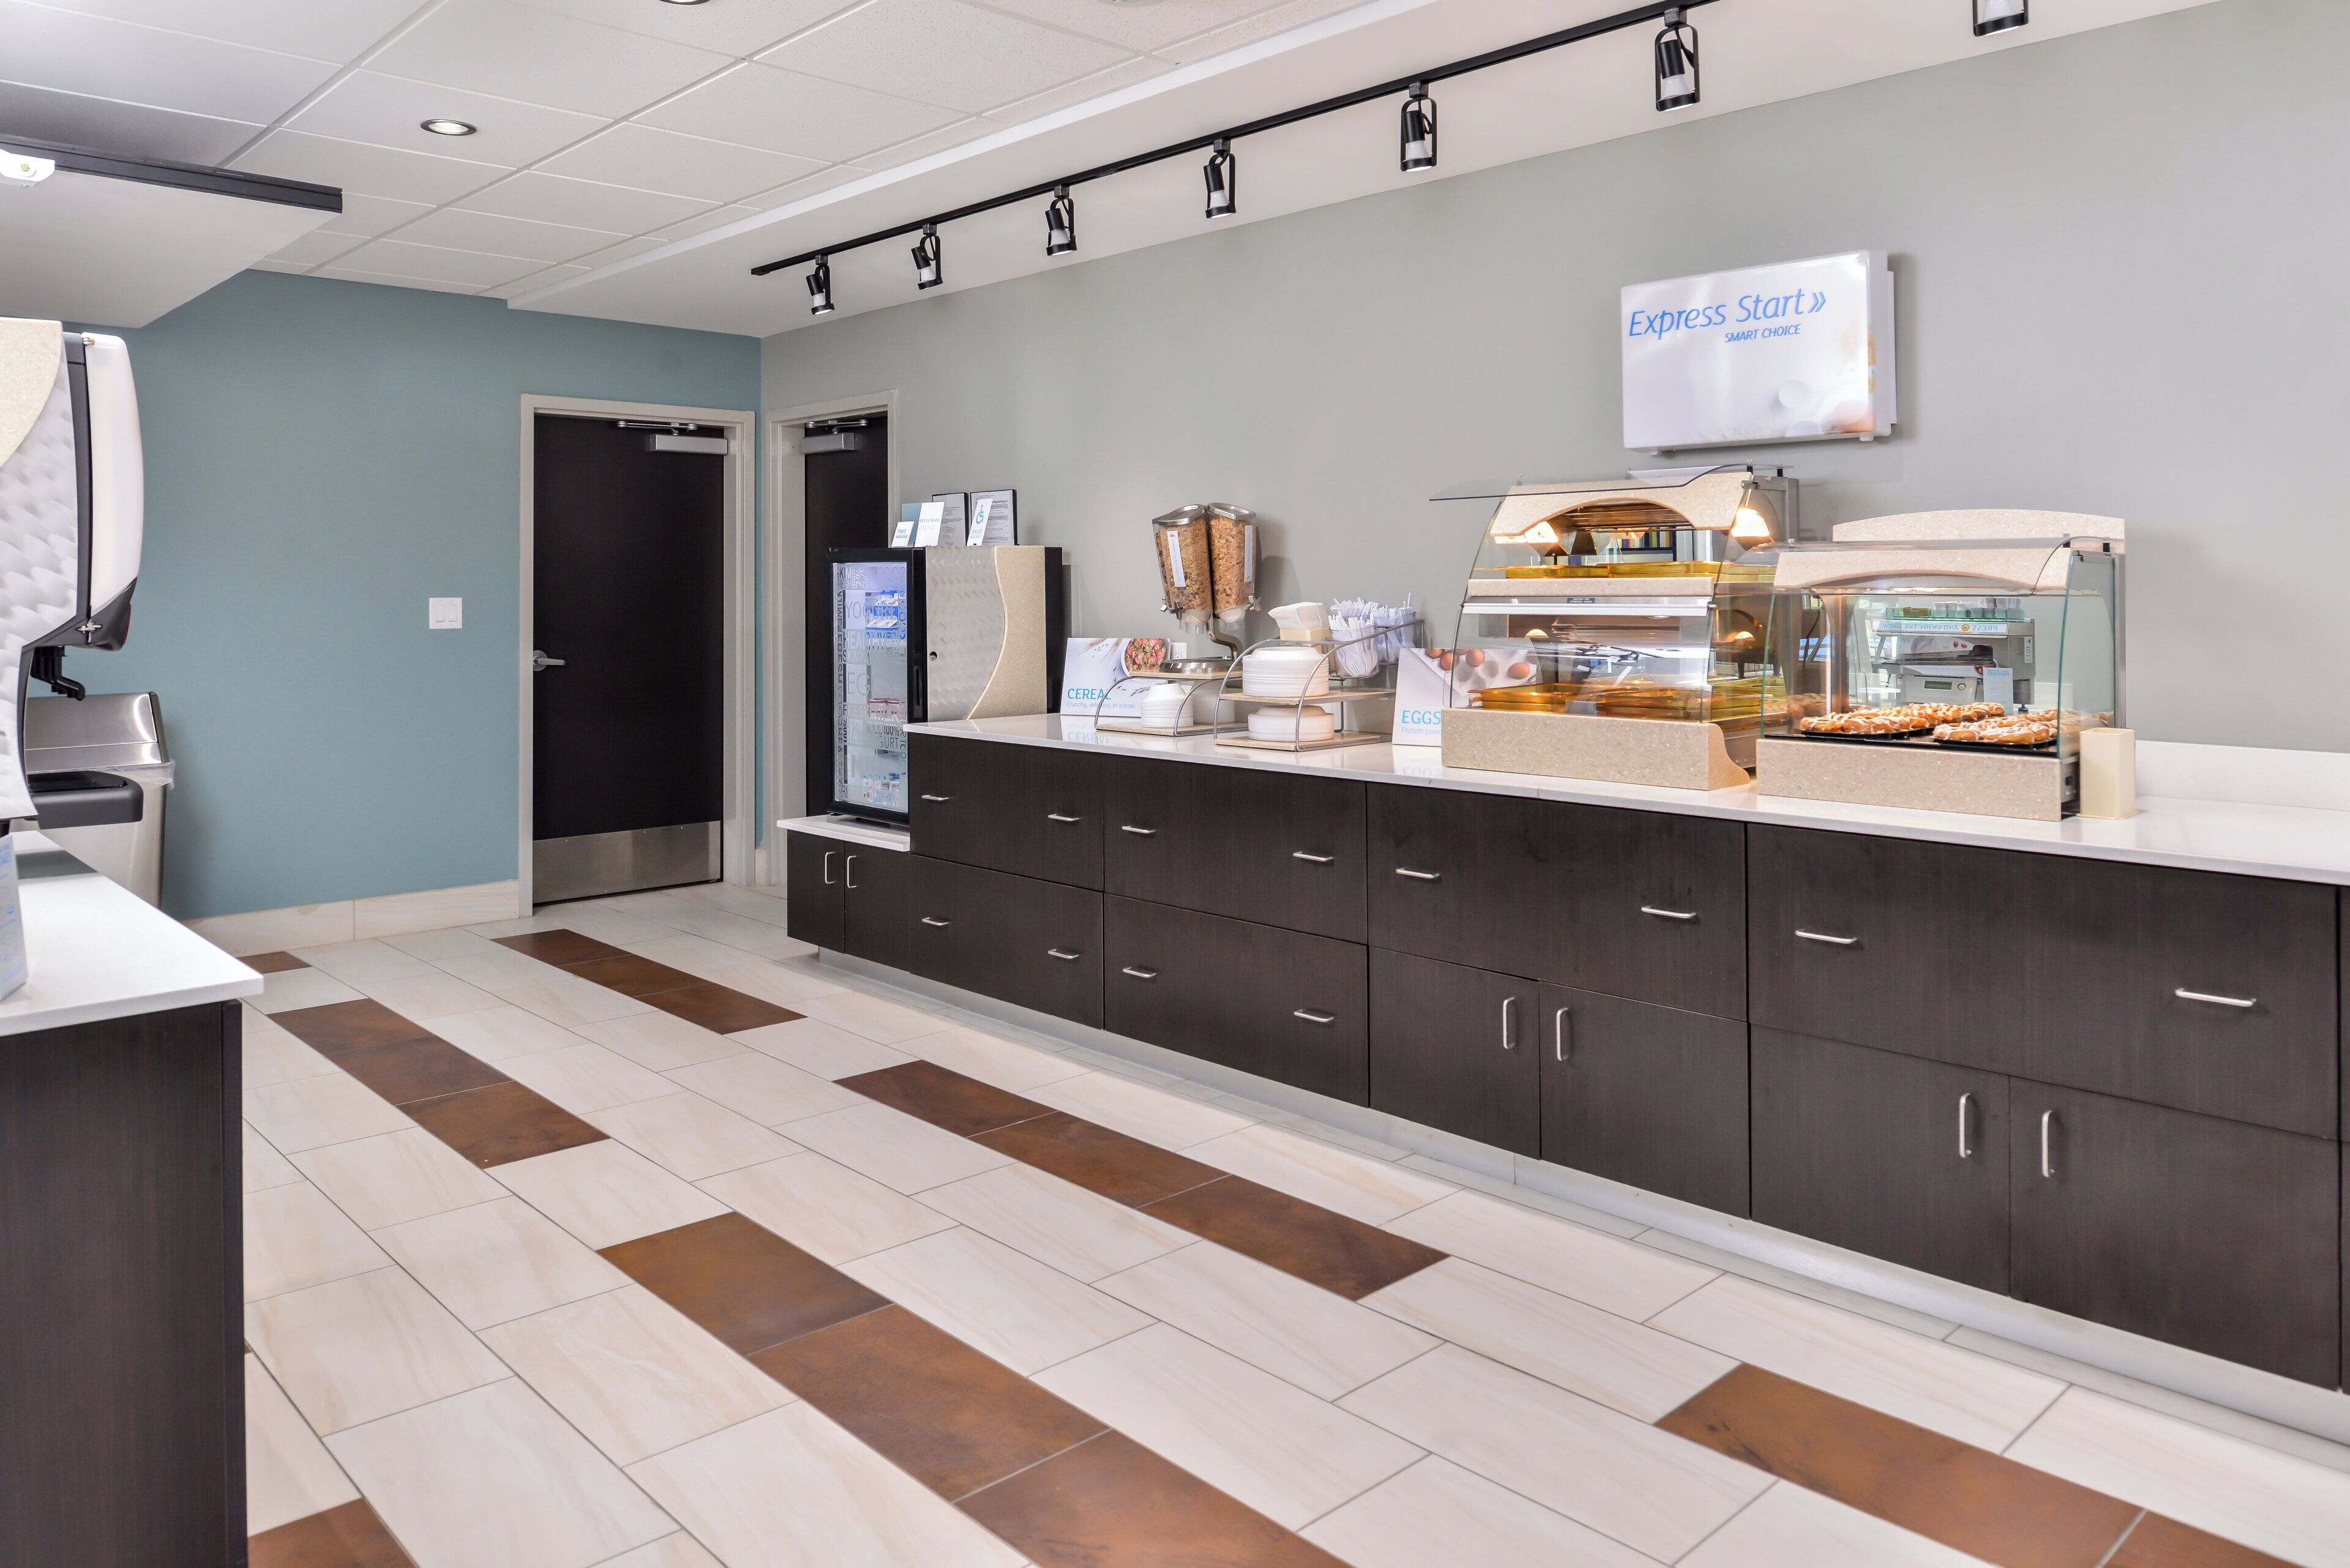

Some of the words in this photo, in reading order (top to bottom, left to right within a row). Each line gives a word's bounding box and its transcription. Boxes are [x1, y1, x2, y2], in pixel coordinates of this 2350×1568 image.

[1628, 304, 1727, 340] Express
[1736, 288, 1805, 323] Start
[1724, 329, 1760, 343] SMART
[1761, 324, 1802, 338] CHOICE
[1067, 688, 1111, 700] CEREAL
[1402, 710, 1442, 725] EGGS
